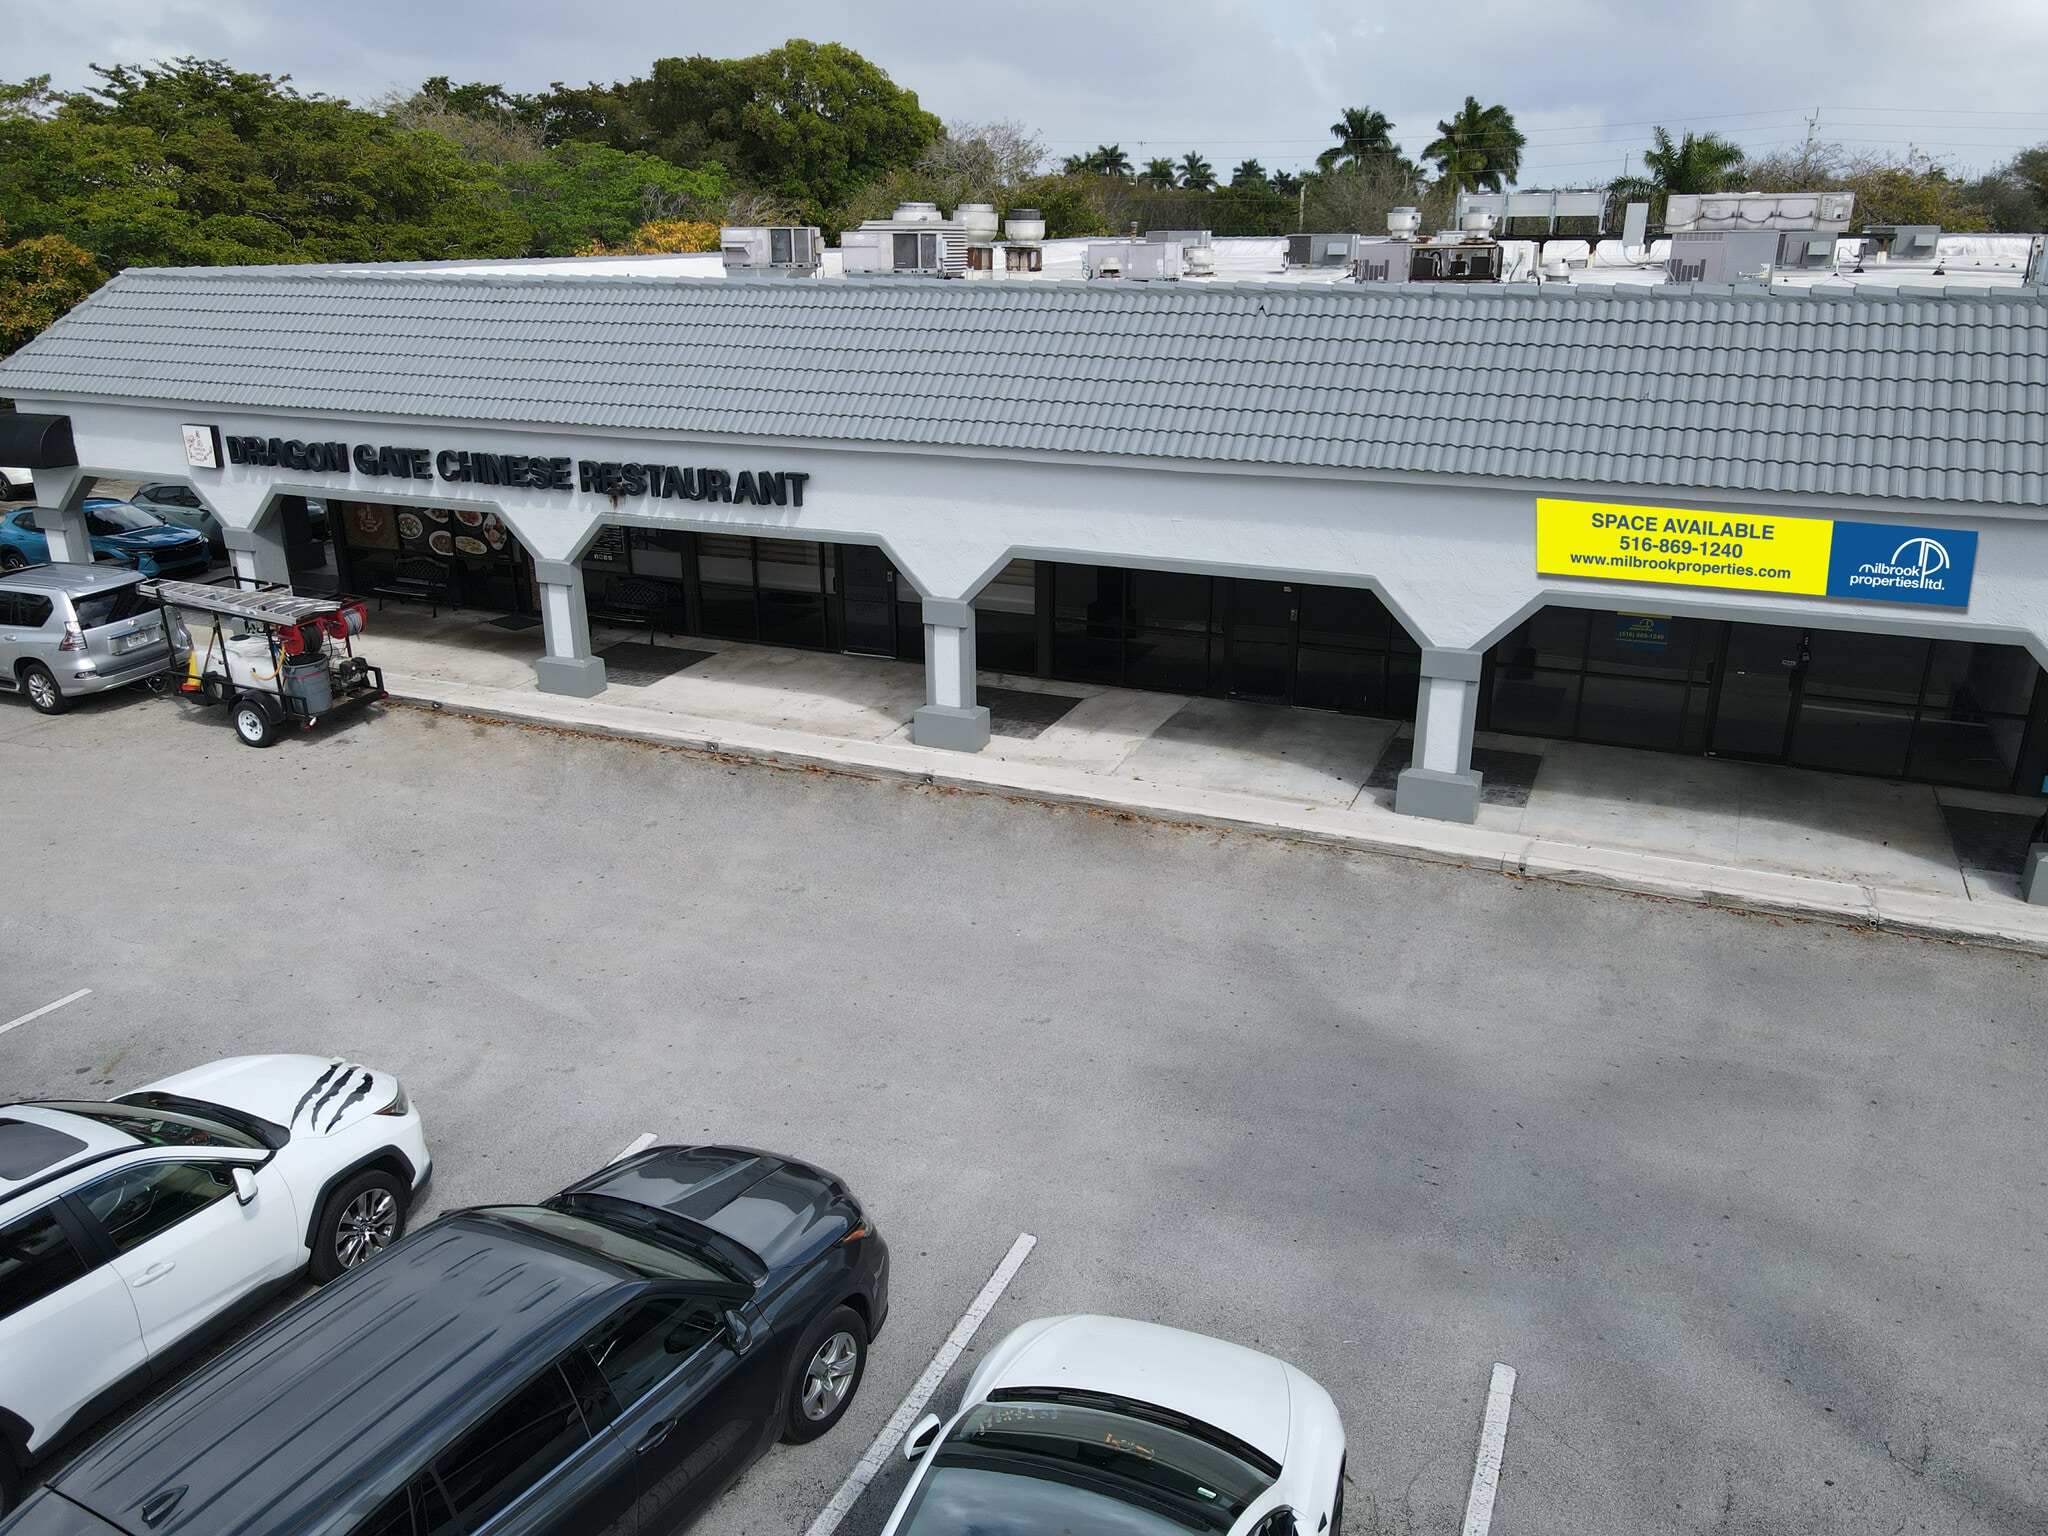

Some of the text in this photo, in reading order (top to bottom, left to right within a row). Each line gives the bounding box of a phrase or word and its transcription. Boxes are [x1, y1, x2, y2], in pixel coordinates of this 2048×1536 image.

[226, 435, 810, 507] DRAGON GATE CHINESE RESTAURANT
[1591, 512, 1775, 540] SPACE AVAILABLE
[1619, 536, 1743, 559] 516-869-1240
[1570, 553, 1791, 579] www.milbrookproperties.com
[1858, 562, 1920, 577] milbrook
[1850, 574, 1945, 591] properties ltd.
